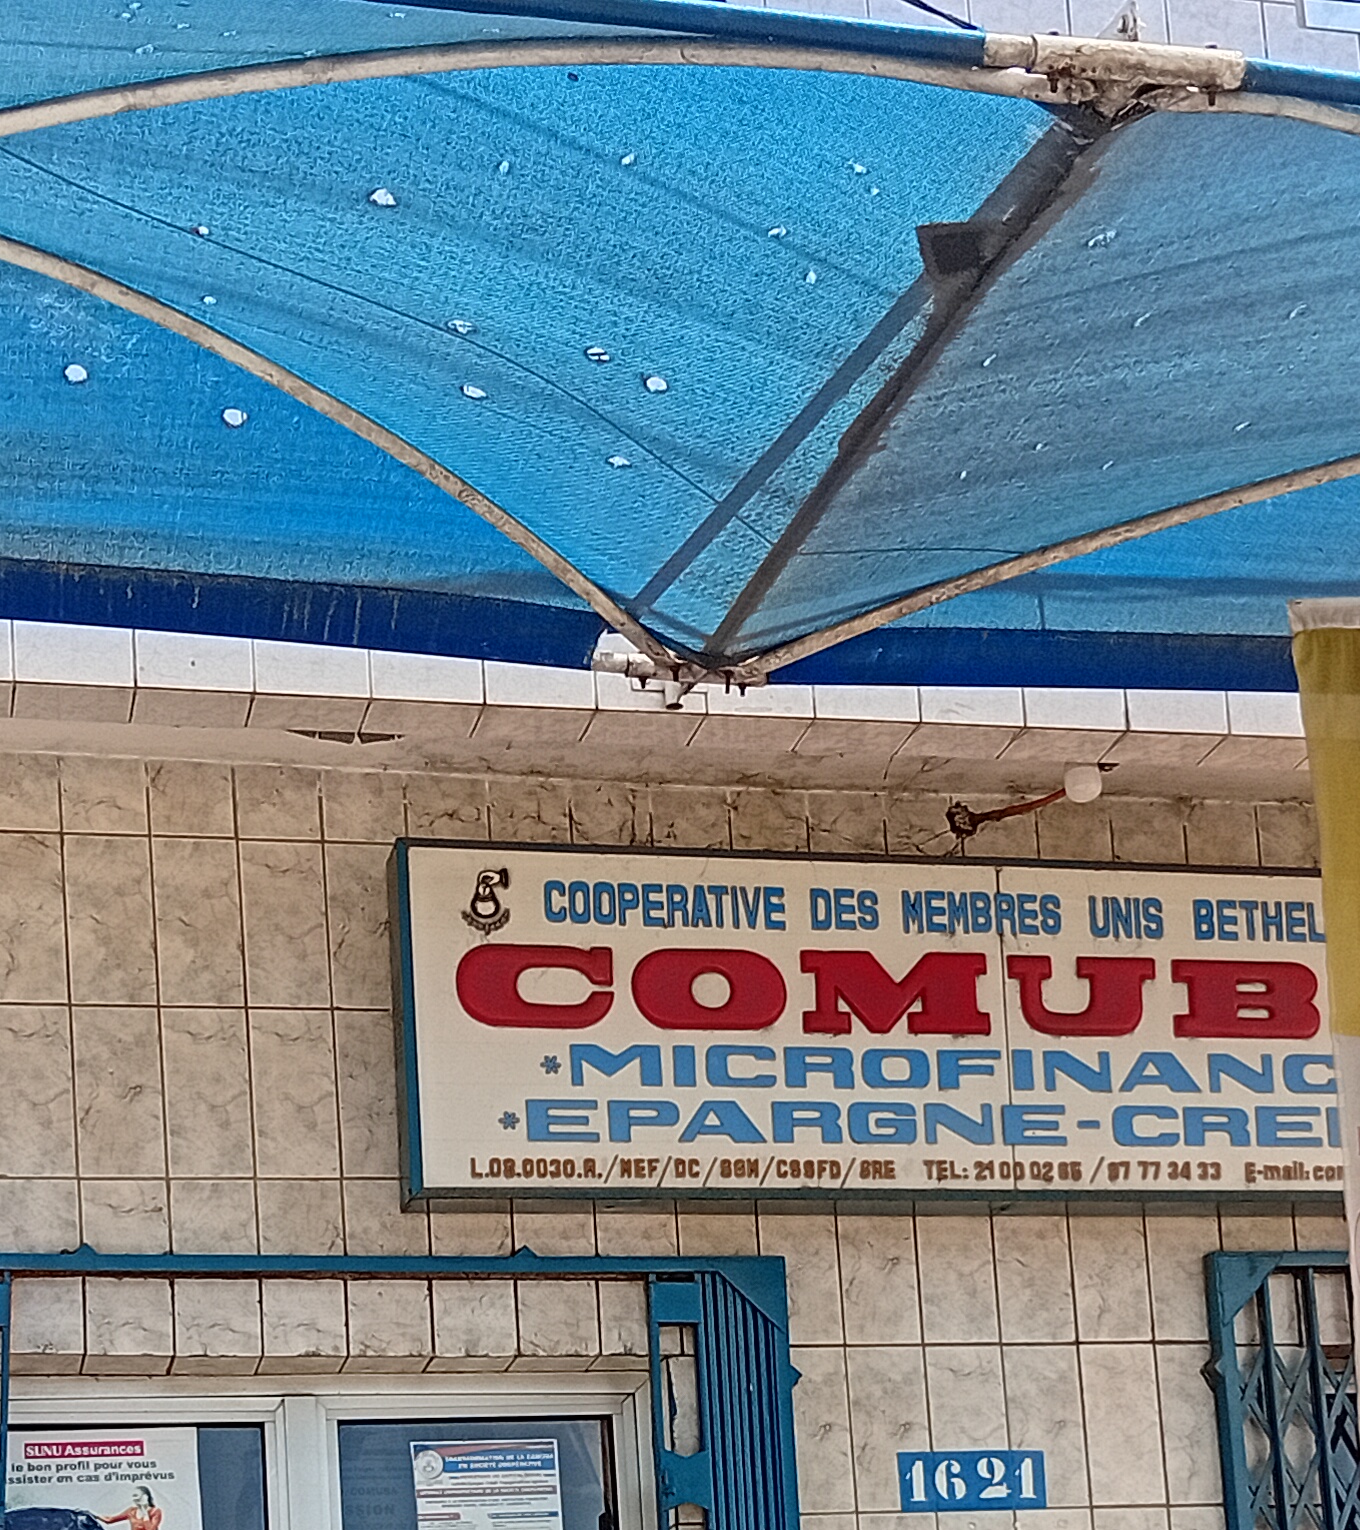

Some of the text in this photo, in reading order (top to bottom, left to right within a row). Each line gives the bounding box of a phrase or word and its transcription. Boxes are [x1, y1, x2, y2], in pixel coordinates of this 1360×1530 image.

[543, 880, 1327, 943] COOPERATIVE DES MEMBRES UNIS BETHEL
[455, 942, 1321, 1040] COMUB
[922, 1159, 969, 1182] TEL:
[973, 1159, 995, 1182] 21
[998, 1160, 1025, 1181] 00
[1029, 1160, 1055, 1183] 02
[1137, 1160, 1161, 1182] 77
[1167, 1160, 1192, 1182] 34
[1196, 1160, 1222, 1182] 33
[25, 1443, 142, 1457] SUNU Assurances
[6, 1470, 176, 1485] ssister en cas d'imprévus
[11, 1460, 157, 1474] le bon profil pour vous
[905, 1457, 1037, 1502] 1621
